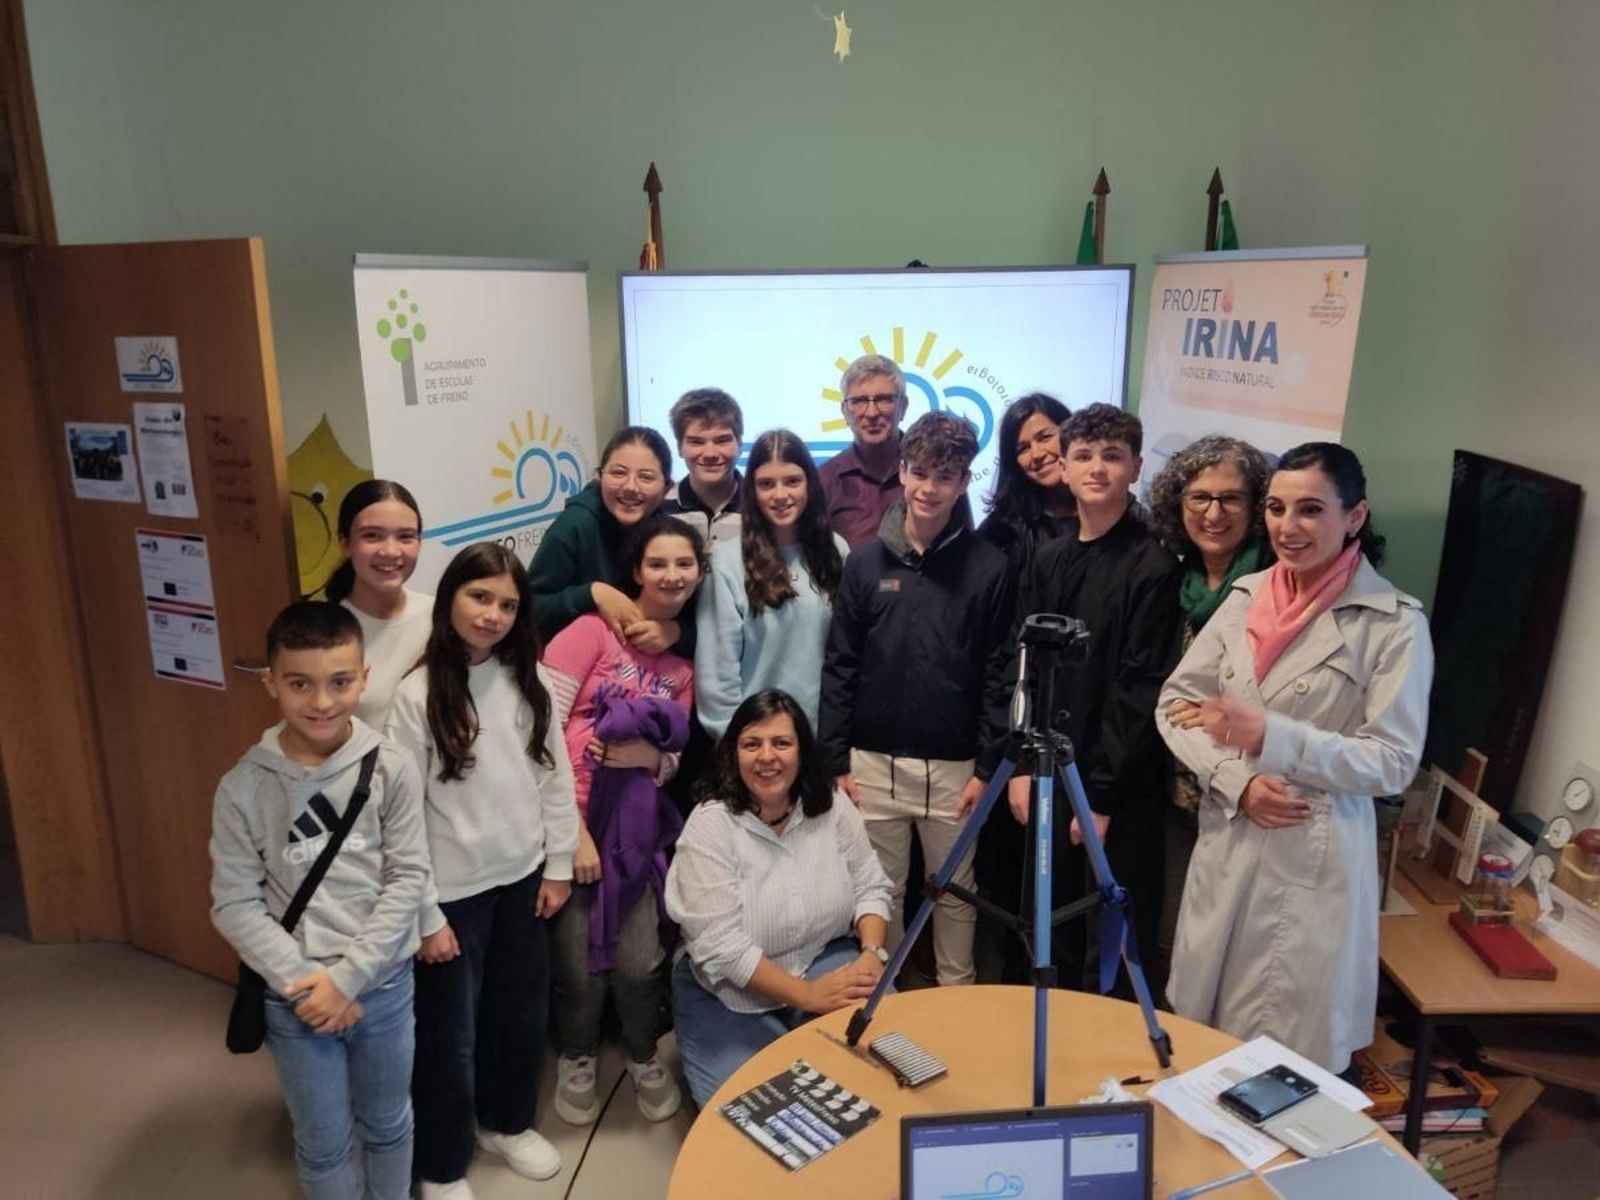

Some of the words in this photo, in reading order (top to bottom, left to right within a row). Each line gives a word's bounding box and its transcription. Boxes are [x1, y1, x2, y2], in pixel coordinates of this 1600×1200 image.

[1182, 317, 1279, 365] IRINA
[424, 357, 487, 371] AGRUPAMENTO
[425, 378, 437, 390] DE
[1232, 371, 1276, 389] NATURAL
[427, 394, 439, 405] DE
